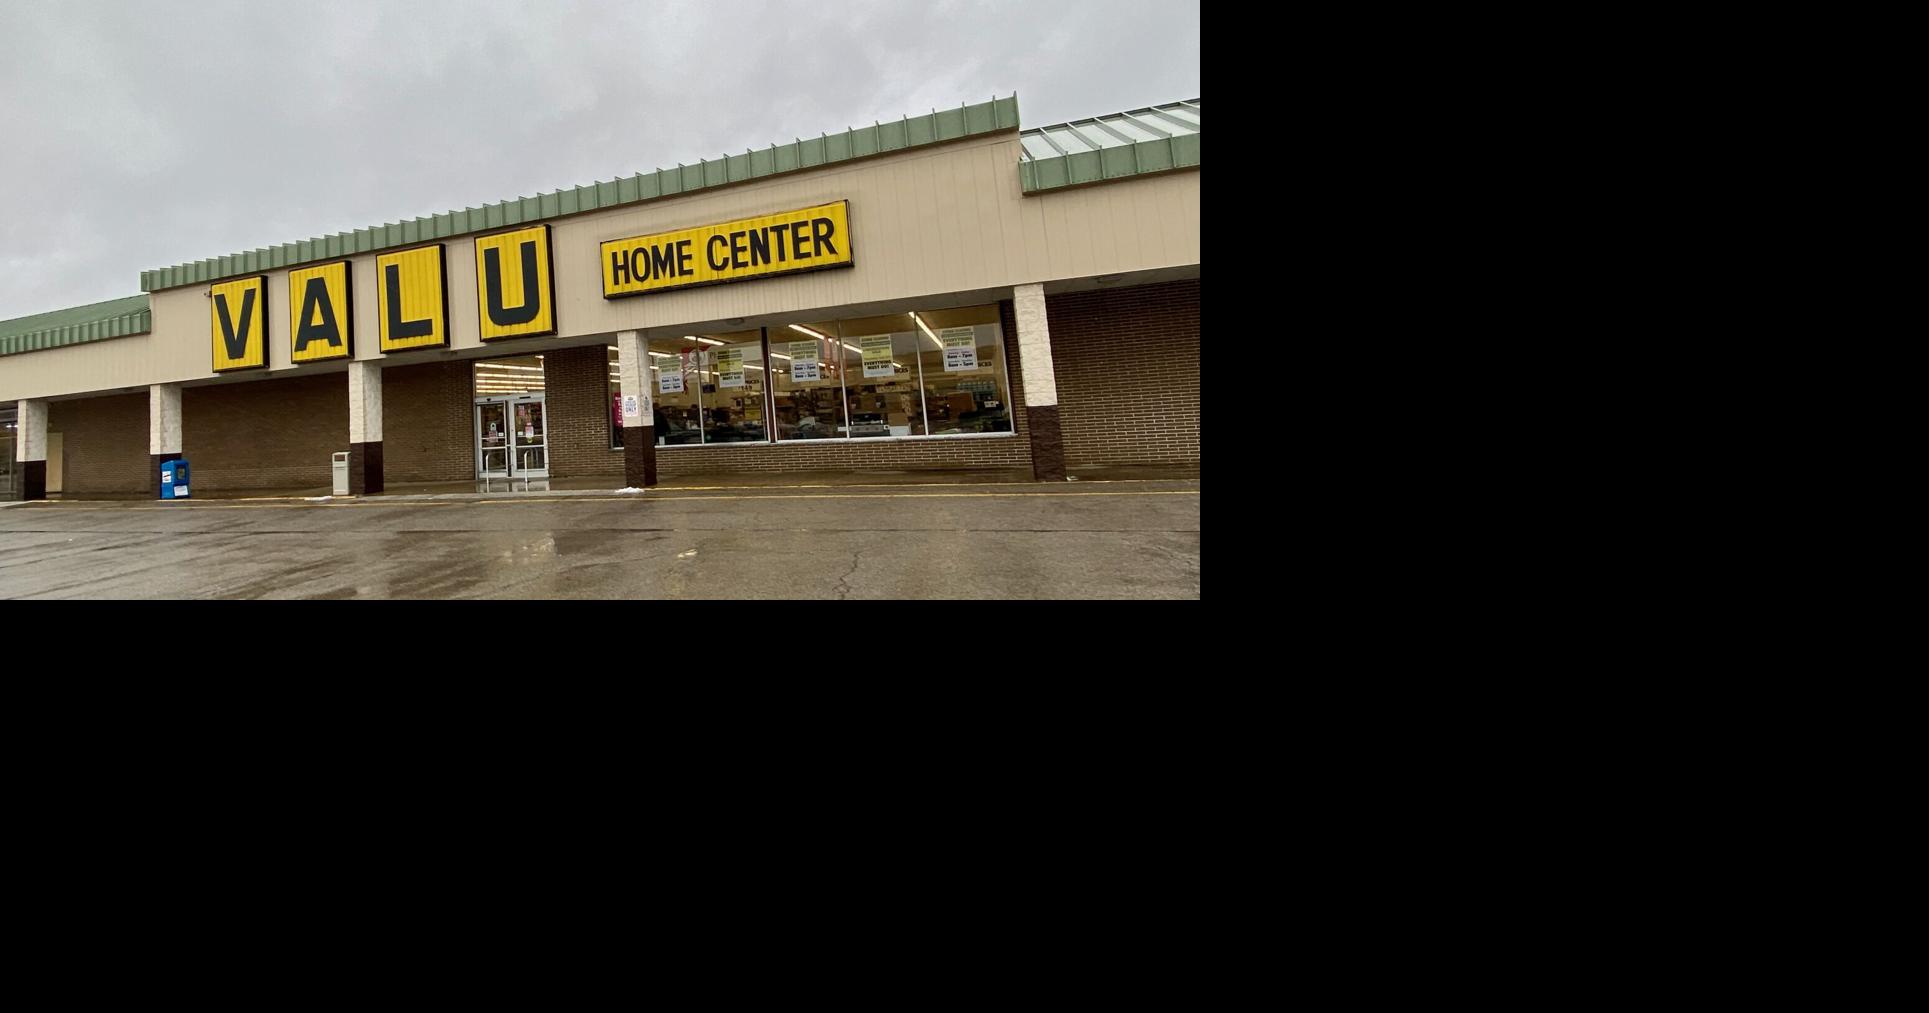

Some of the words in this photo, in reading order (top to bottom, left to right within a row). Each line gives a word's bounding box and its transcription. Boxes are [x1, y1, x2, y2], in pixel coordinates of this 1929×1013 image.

[611, 239, 694, 286] HOME
[706, 217, 839, 271] CENTER
[213, 240, 540, 360] VALU
